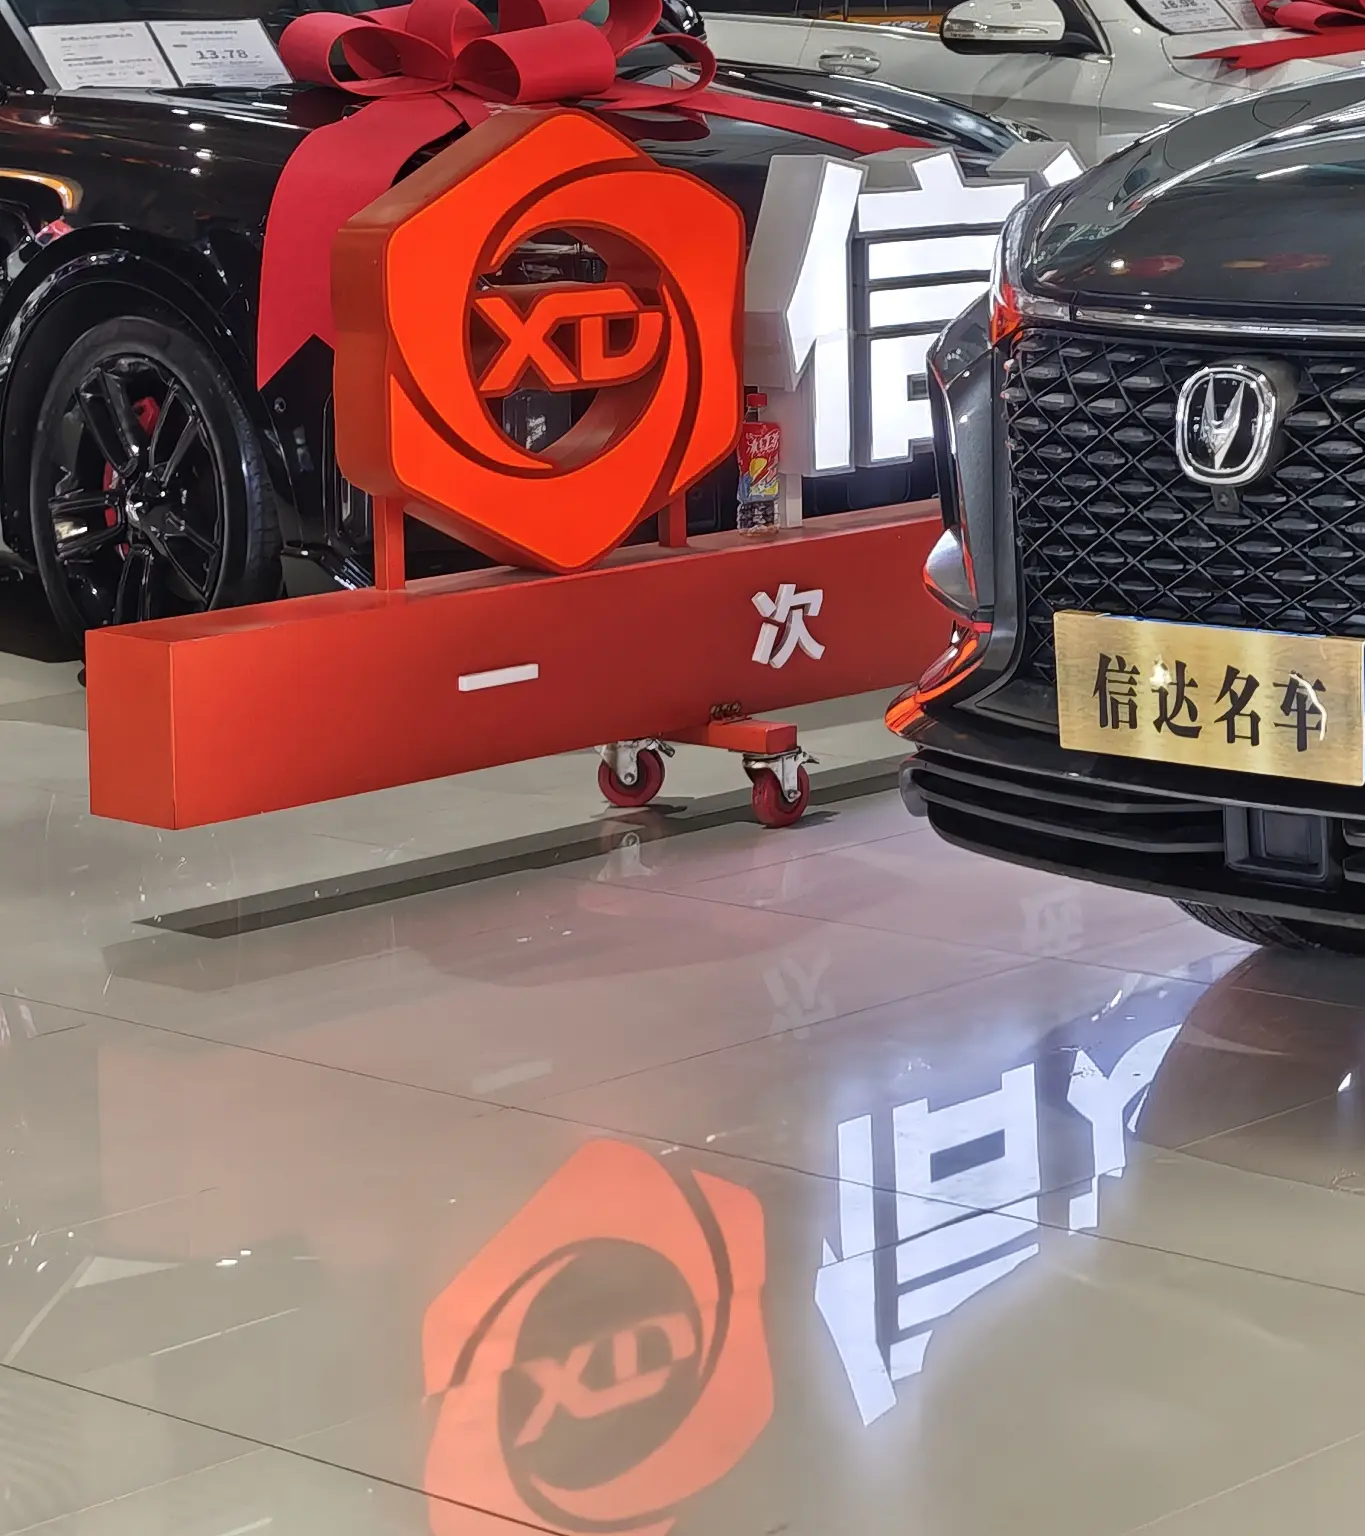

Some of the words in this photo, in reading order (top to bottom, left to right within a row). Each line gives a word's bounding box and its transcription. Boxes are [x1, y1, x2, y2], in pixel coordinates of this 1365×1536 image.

[195, 48, 250, 60] 13.78
[474, 280, 667, 397] XD
[749, 582, 827, 670] 次
[1089, 652, 1330, 753] 信达名车
